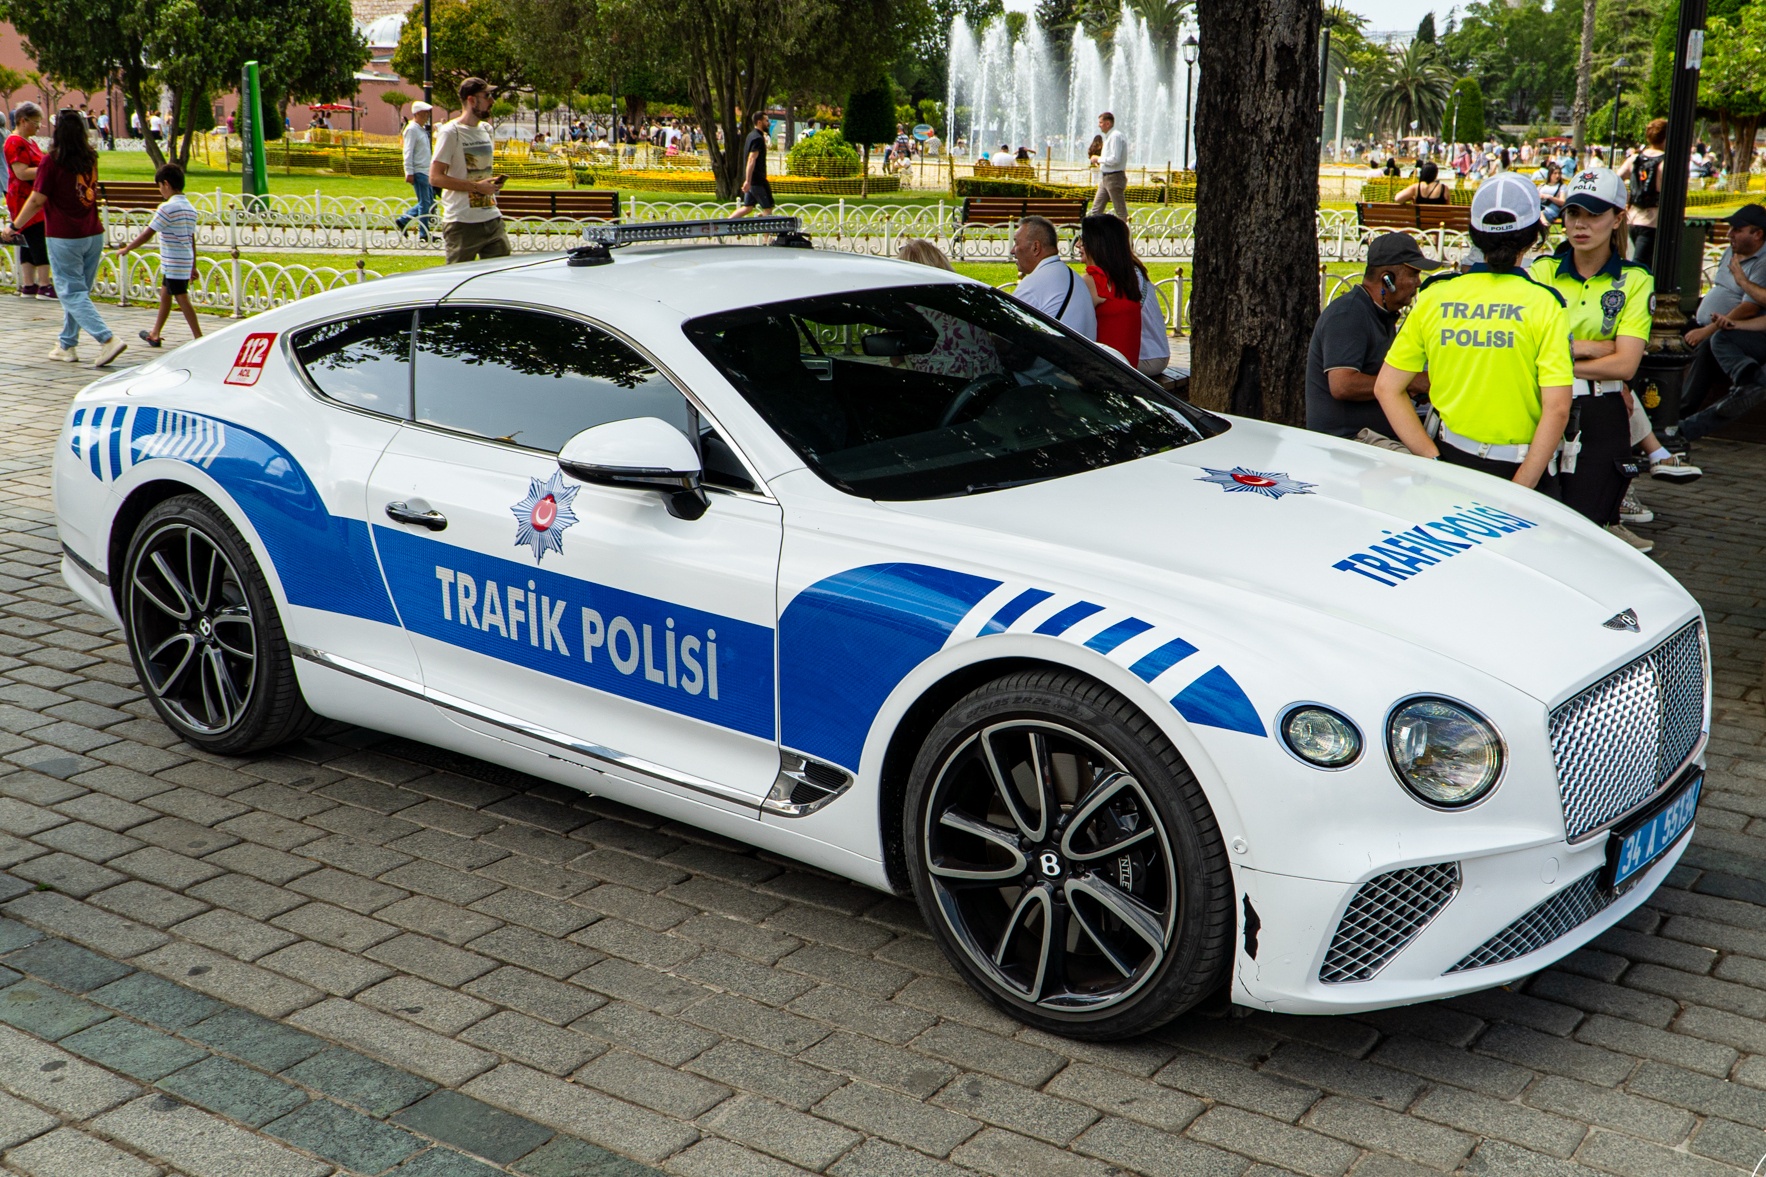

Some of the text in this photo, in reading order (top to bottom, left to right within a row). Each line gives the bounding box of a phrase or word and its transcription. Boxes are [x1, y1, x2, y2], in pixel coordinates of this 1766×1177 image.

[240, 338, 269, 364] 112
[1331, 501, 1539, 587] TRAFİK POLİSİ
[435, 565, 719, 701] TRAFİK POLİSİ
[1039, 853, 1061, 876] B
[1621, 830, 1642, 874] 34
[1645, 819, 1658, 858] A
